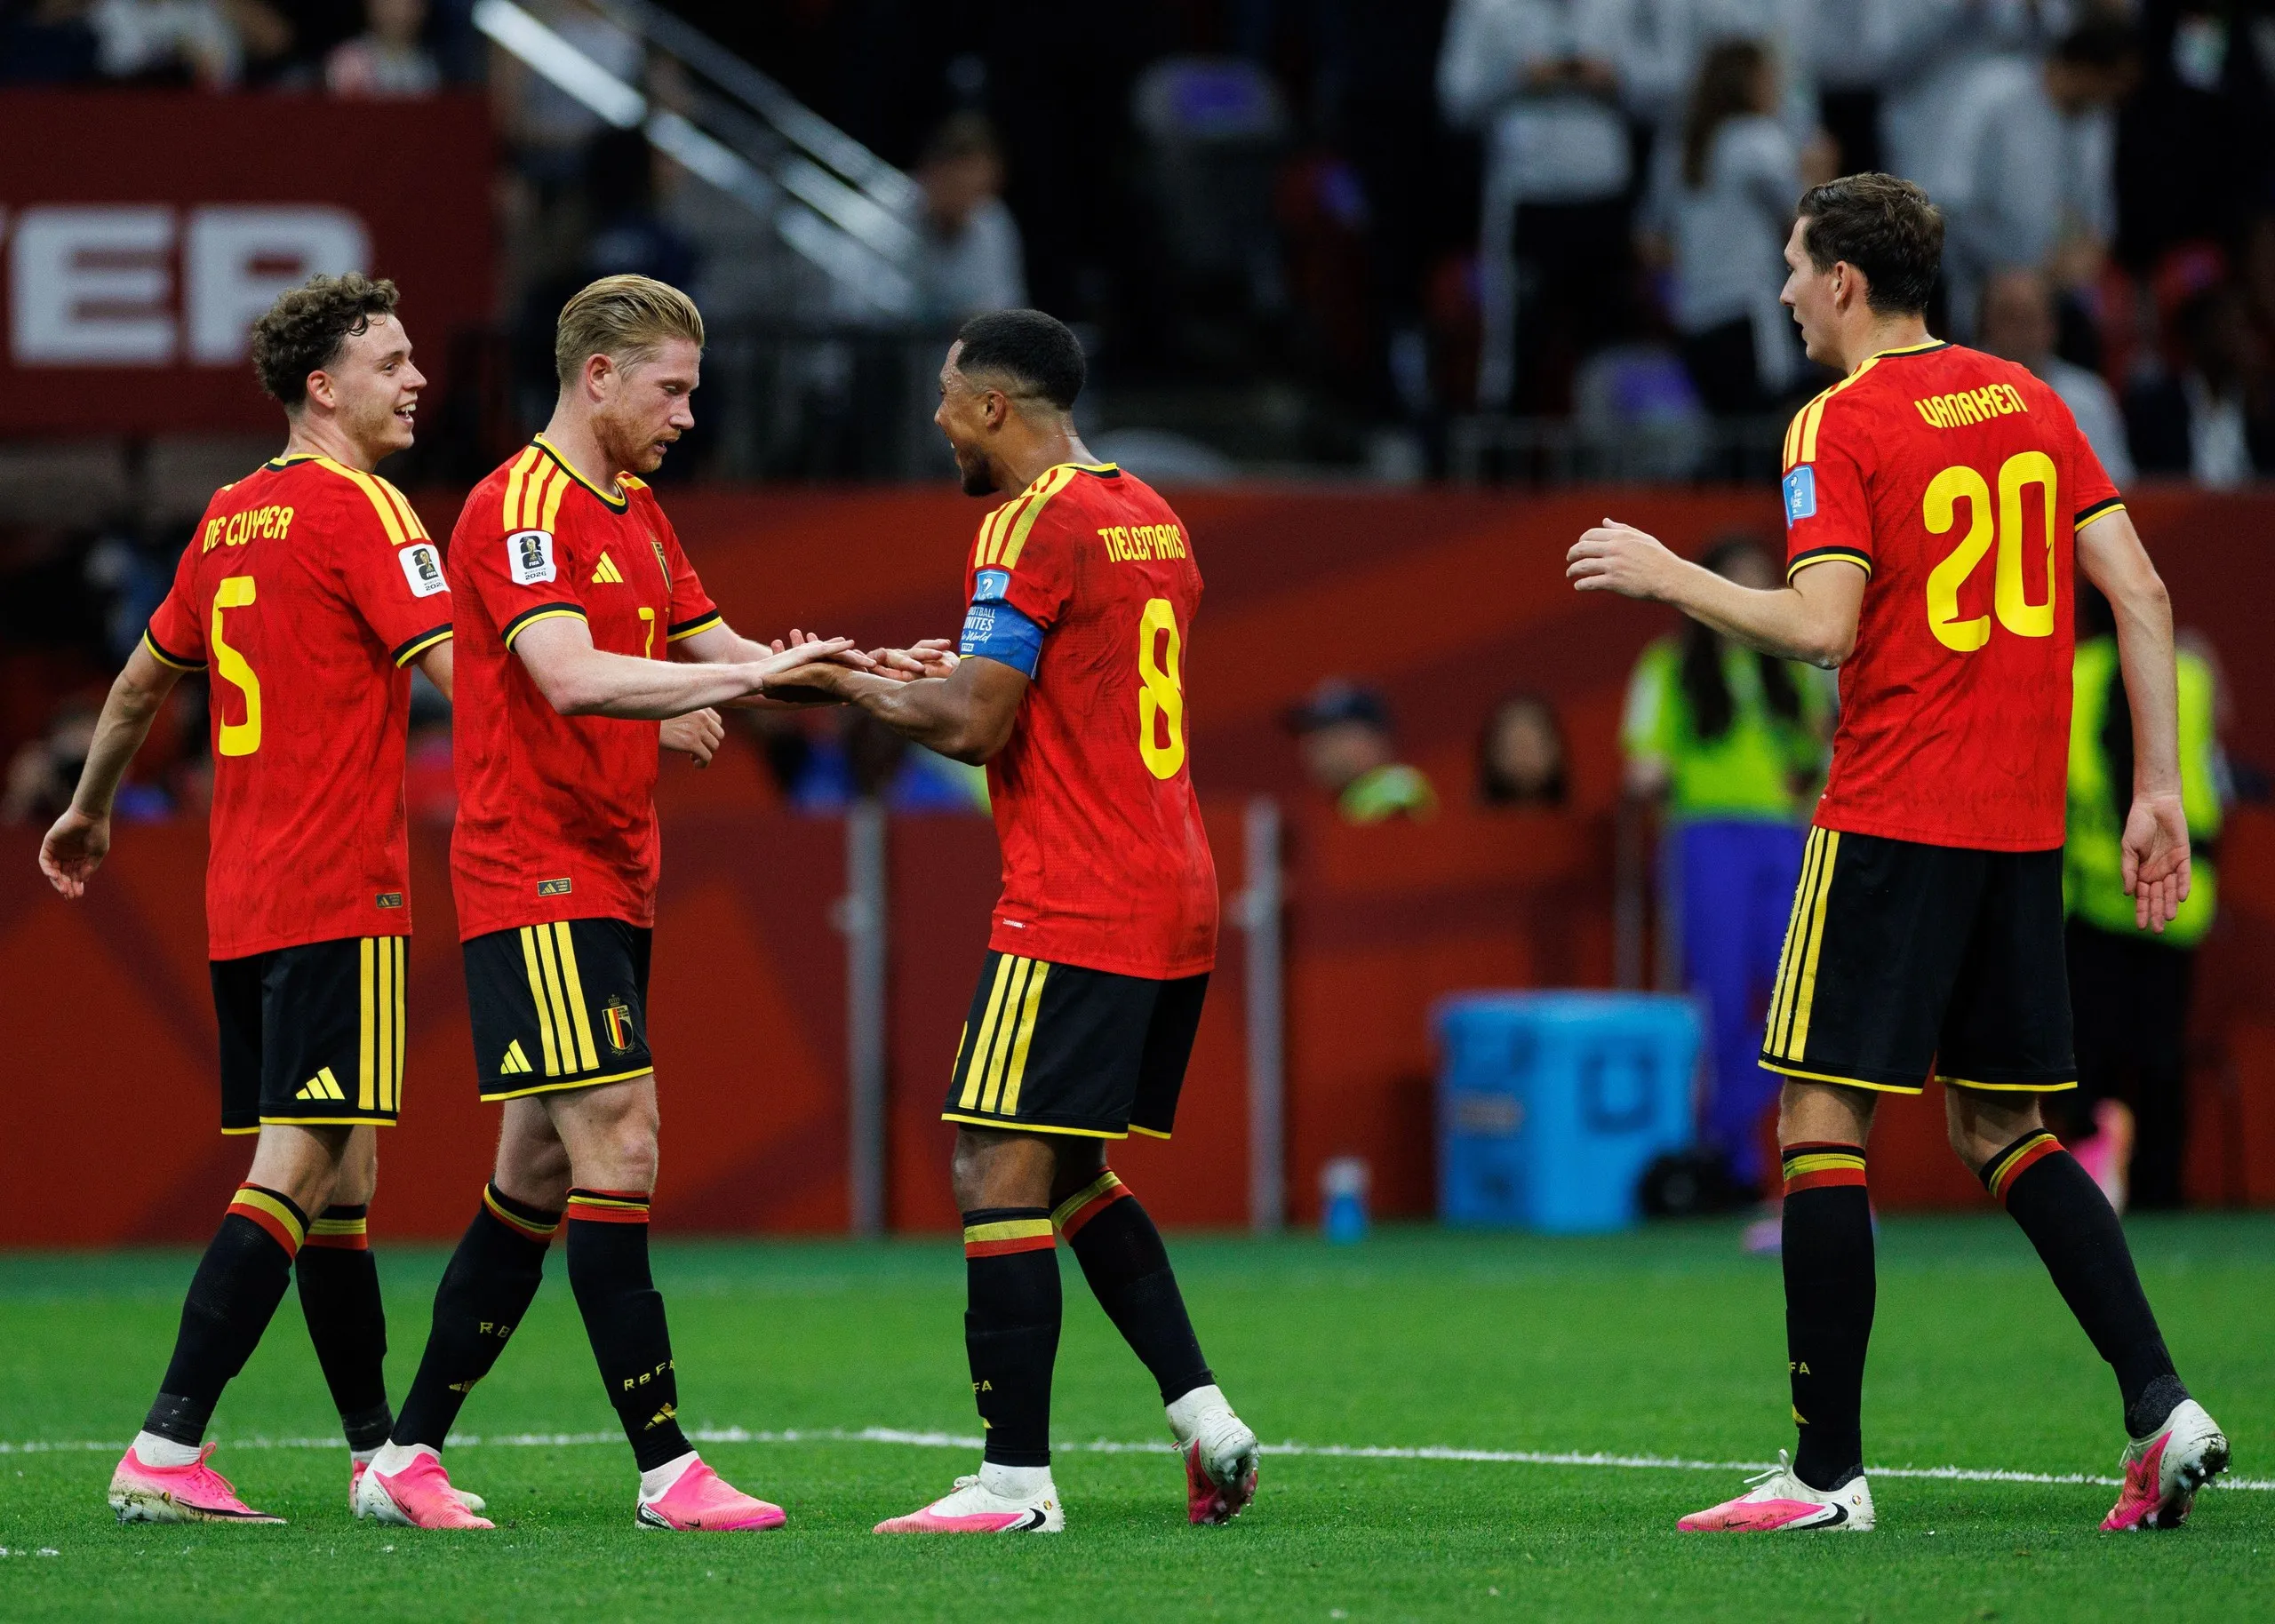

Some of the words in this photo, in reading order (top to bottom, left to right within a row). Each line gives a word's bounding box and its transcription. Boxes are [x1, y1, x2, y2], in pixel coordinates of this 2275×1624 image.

[1913, 383, 2029, 429] VANAKEN
[202, 515, 228, 554] DE
[225, 505, 295, 547] CUYPER
[1097, 523, 1186, 563] TIELEMANS
[1922, 450, 2057, 652] 20
[524, 571, 547, 580] 2026
[211, 575, 262, 757] 5
[1138, 597, 1185, 780] 8
